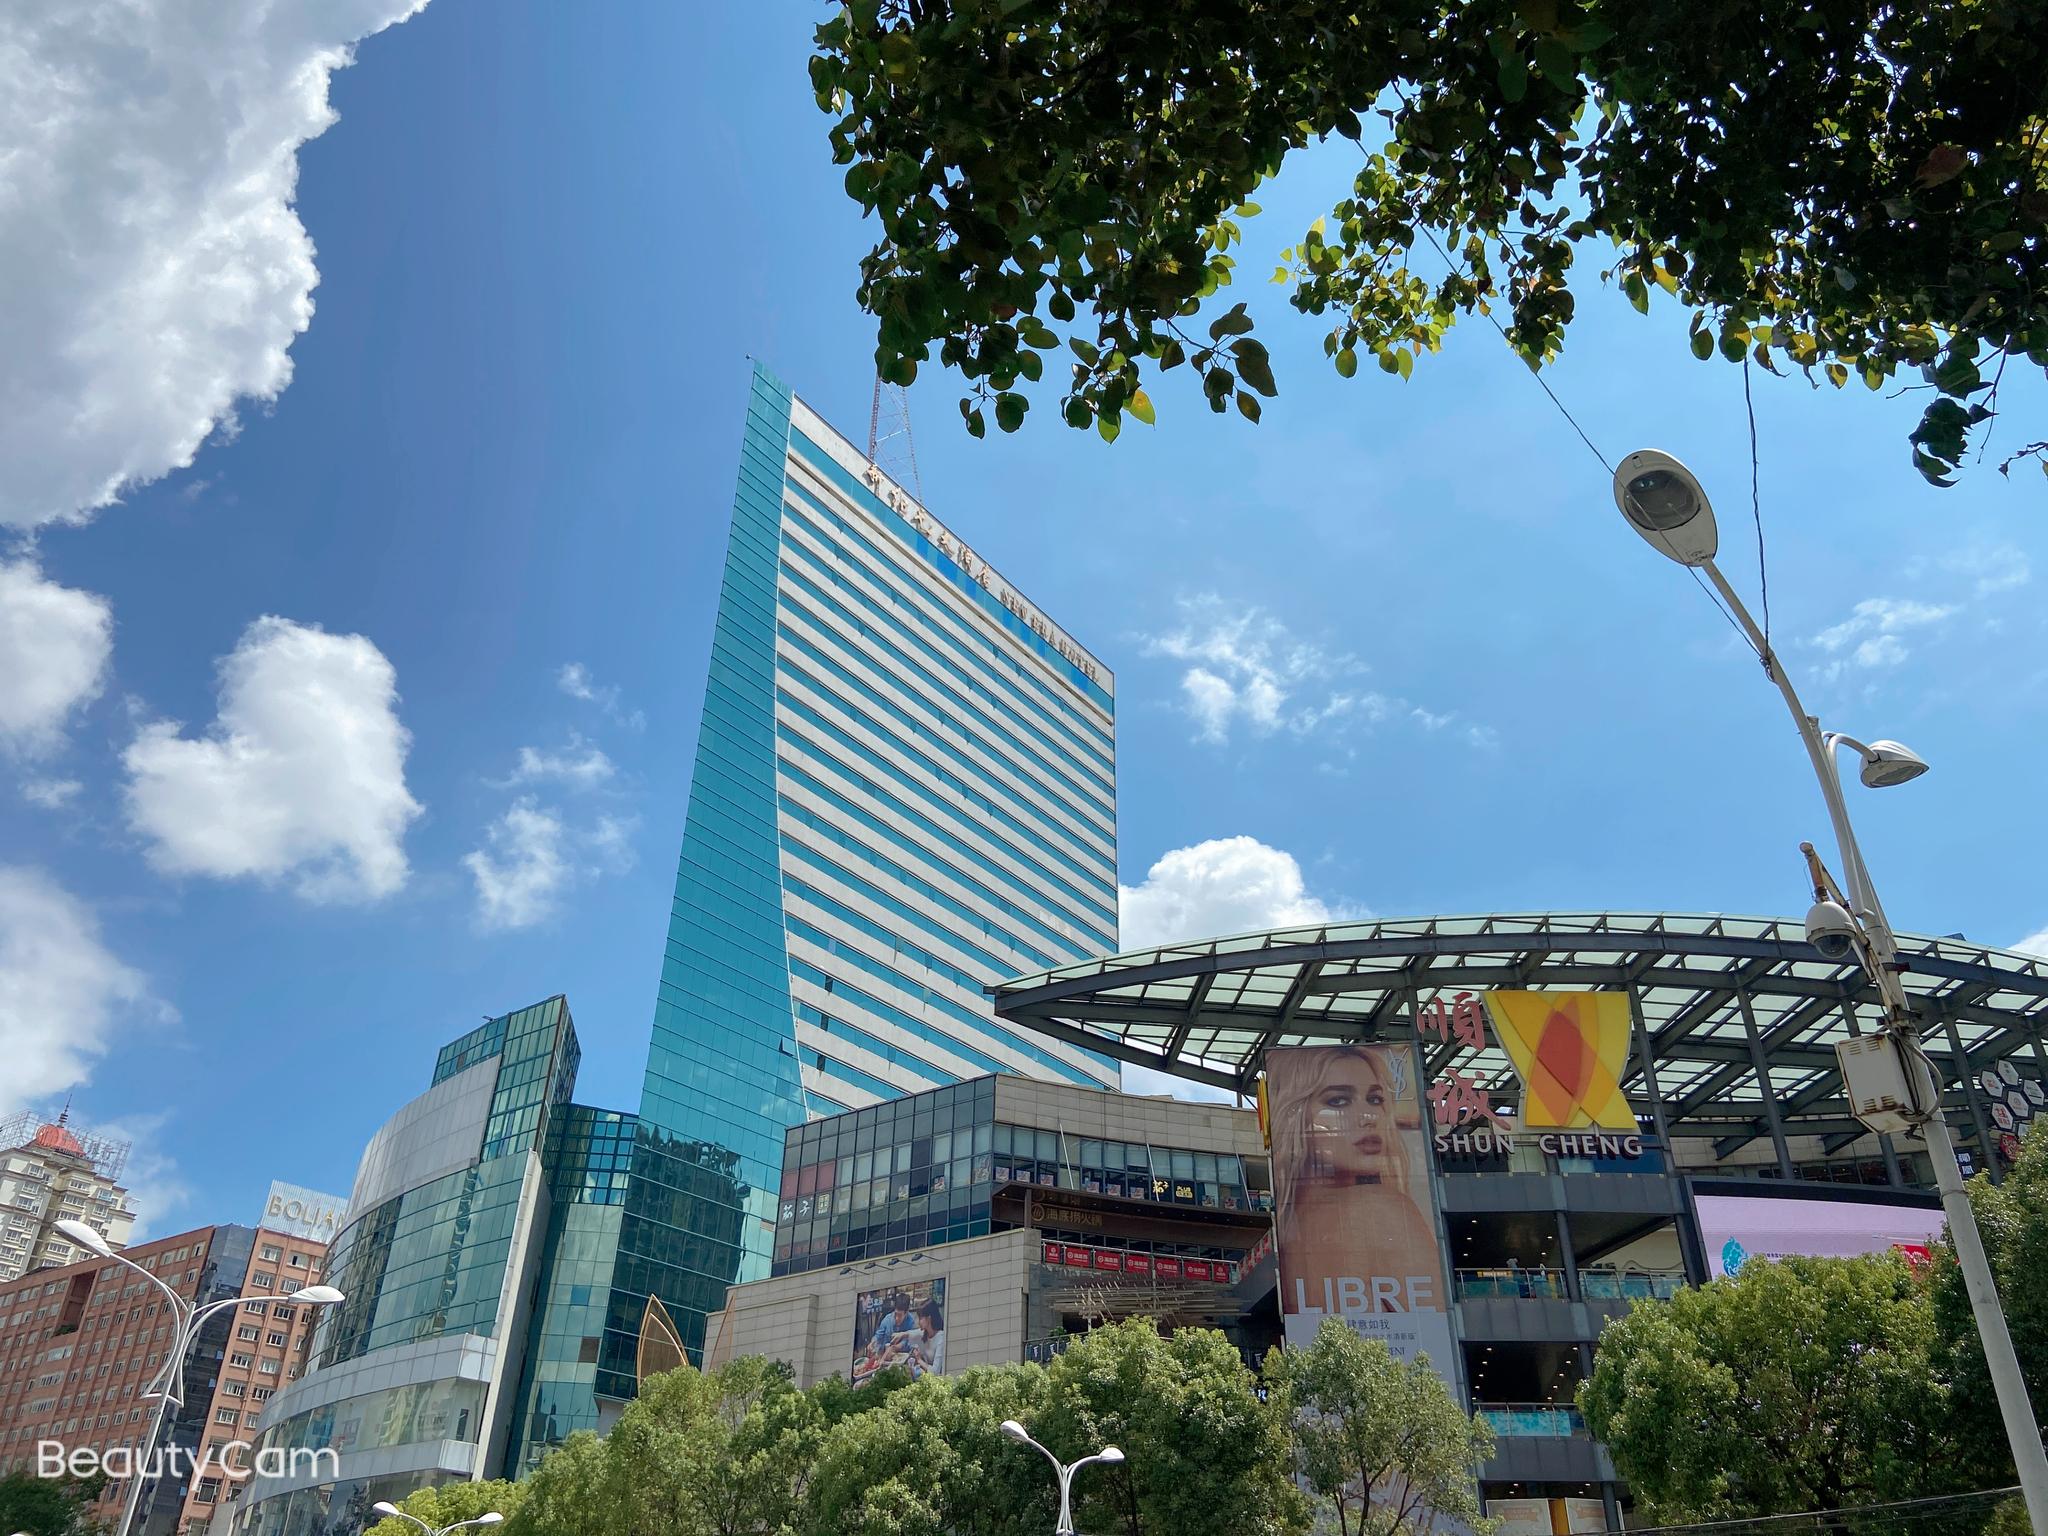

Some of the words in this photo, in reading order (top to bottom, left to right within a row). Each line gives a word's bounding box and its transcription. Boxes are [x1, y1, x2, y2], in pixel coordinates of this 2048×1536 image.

[1000, 588, 1028, 620] NEW
[1030, 613, 1058, 646] ERA
[1059, 638, 1100, 683] HOTEL
[1434, 1133, 1515, 1154] SHUN
[1539, 1134, 1644, 1156] CHENG
[1296, 1276, 1437, 1313] LIBRE
